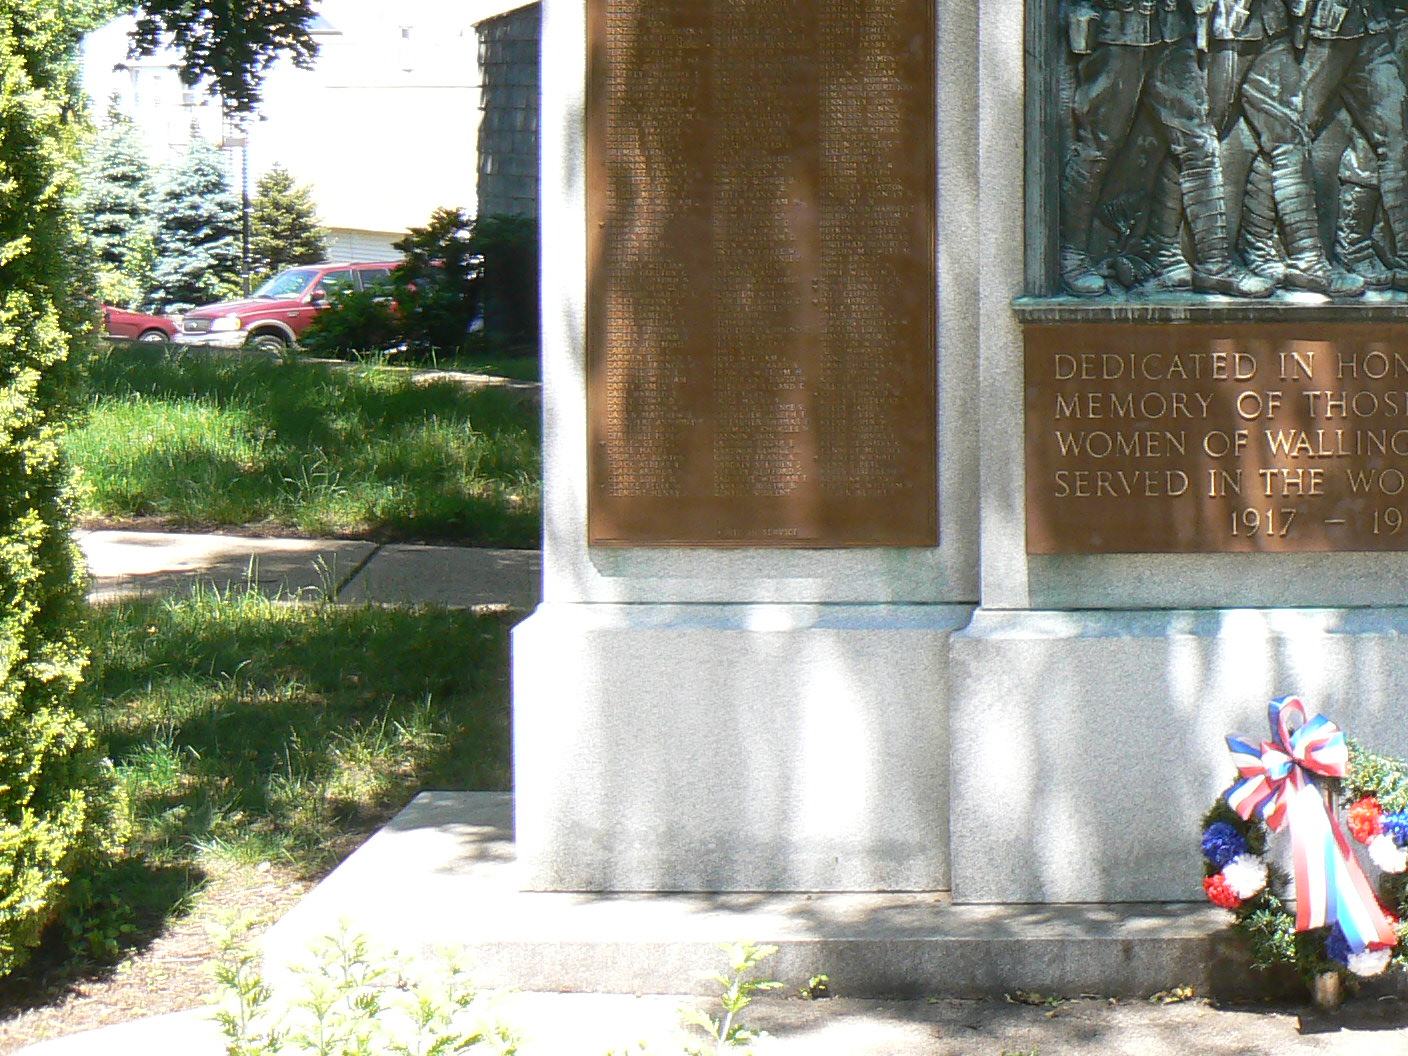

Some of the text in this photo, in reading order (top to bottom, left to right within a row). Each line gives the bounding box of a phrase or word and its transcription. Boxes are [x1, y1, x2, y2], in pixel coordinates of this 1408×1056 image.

[1054, 352, 1258, 382] DEDICATED
[1279, 351, 1315, 380] IN
[1054, 392, 1215, 420] MEMORY
[1236, 390, 1283, 421] OF
[1054, 430, 1187, 458] WOMEN
[1203, 429, 1249, 458] OF
[1054, 470, 1190, 497] SERVED
[1209, 469, 1243, 497] IN
[1258, 468, 1325, 496] THE
[1231, 507, 1297, 537] 1917
